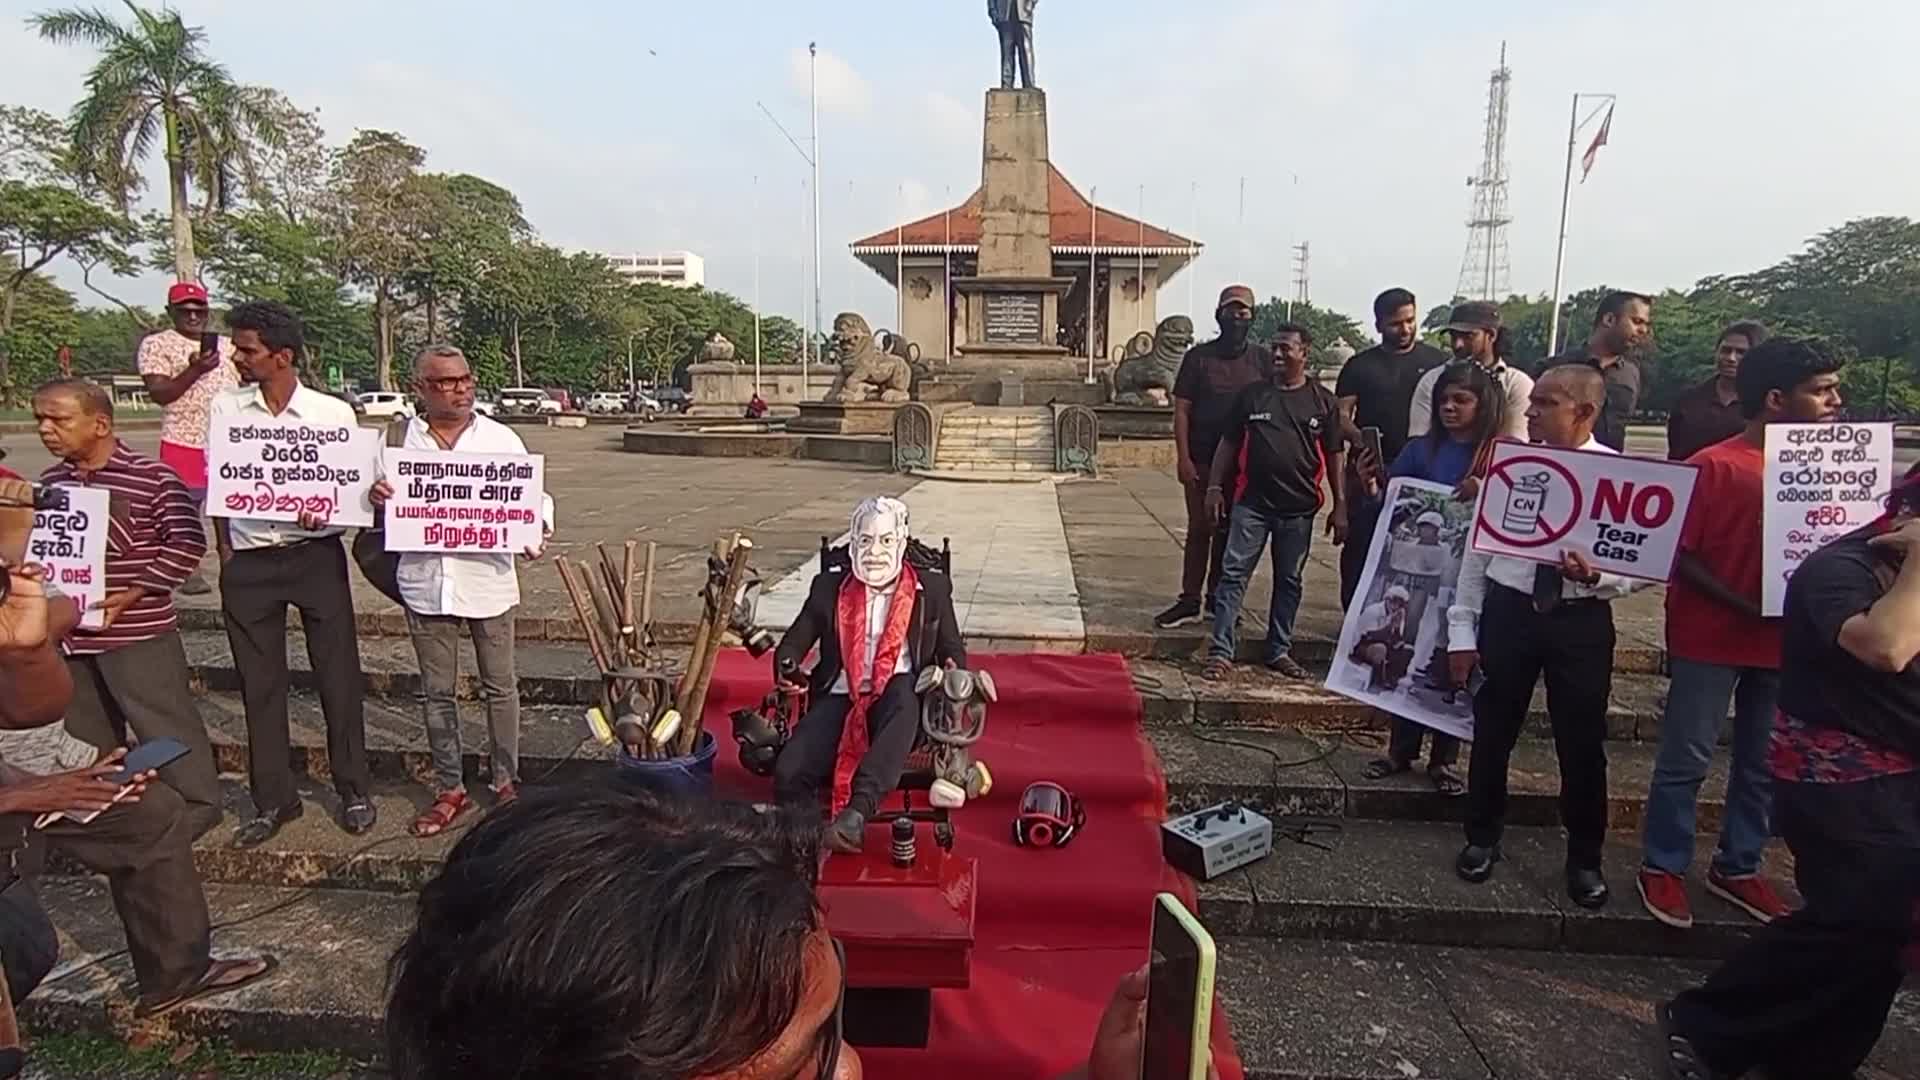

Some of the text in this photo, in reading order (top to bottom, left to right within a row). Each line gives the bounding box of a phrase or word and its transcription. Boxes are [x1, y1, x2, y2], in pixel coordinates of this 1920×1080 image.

[1787, 424, 1872, 446] ඇස්වල
[261, 445, 319, 463] එරෙහි
[1779, 449, 1824, 466] කඳුළු
[398, 461, 533, 482] ஜனநாயகத்தின்
[1779, 468, 1877, 488] රෝහලේ
[408, 478, 523, 503] மீதான அரச
[396, 504, 535, 524] பயங்கரவாதத்தை
[1513, 498, 1536, 512] CN
[1590, 478, 1675, 529] NO
[1596, 523, 1648, 546] Tear
[1593, 541, 1640, 563] Gas
